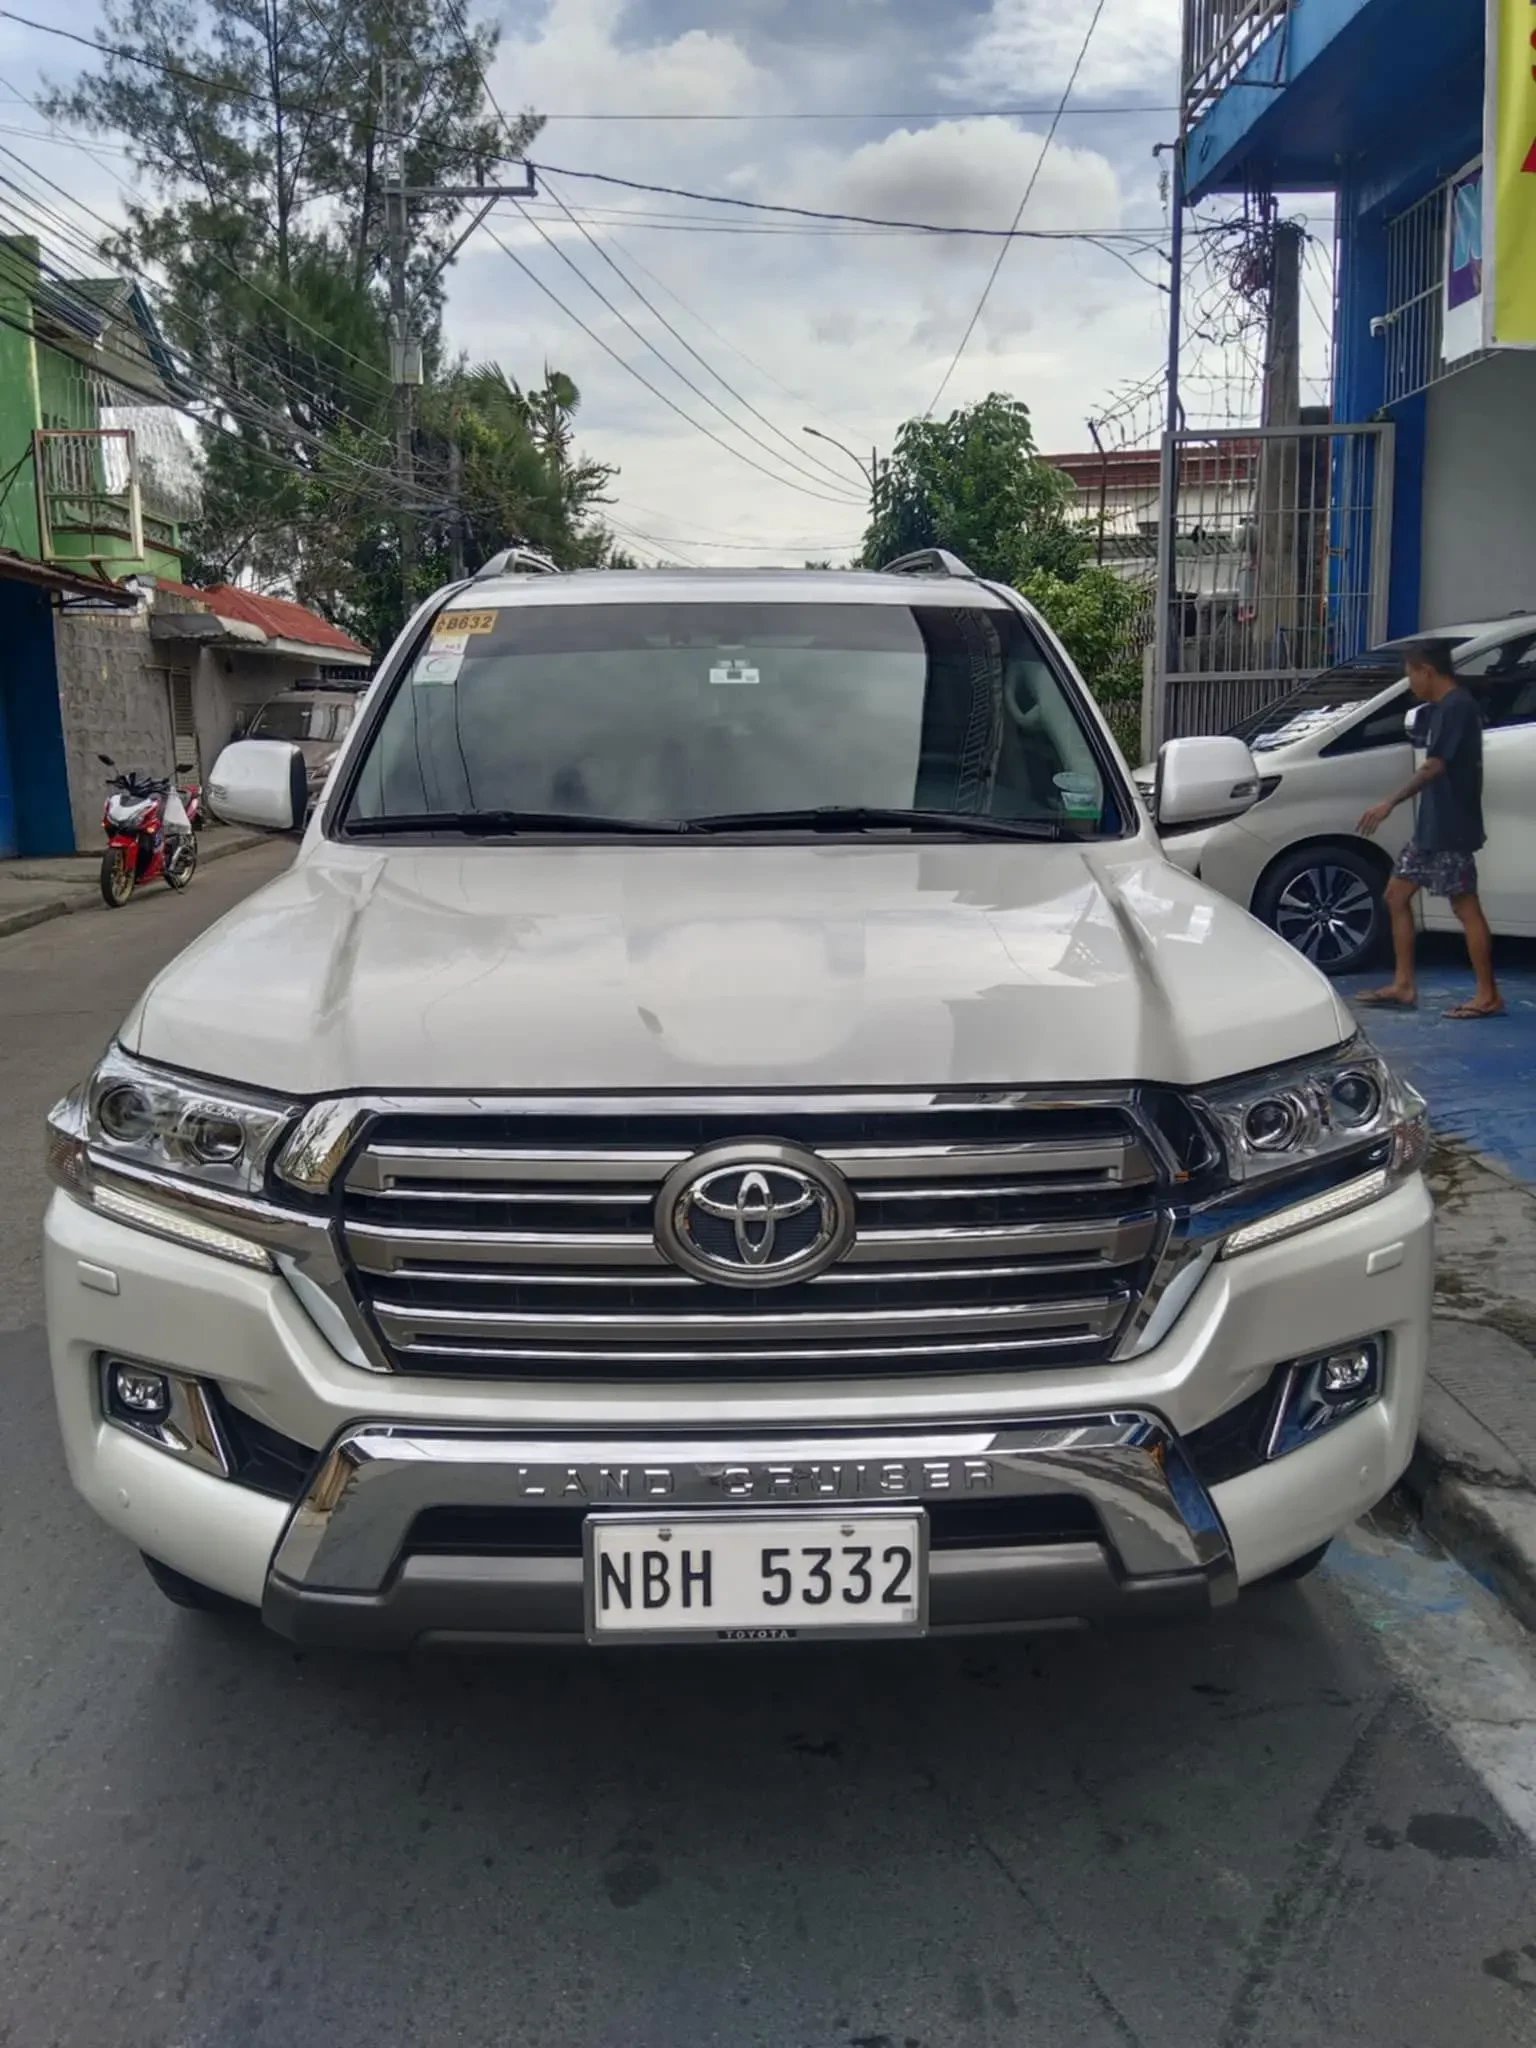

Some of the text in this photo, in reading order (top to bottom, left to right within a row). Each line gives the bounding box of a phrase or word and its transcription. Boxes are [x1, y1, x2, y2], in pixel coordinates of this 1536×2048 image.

[518, 1460, 993, 1498] LAND CRUISER
[600, 1546, 912, 1610] NBH 5332
[726, 1629, 790, 1641] TOYOTA
